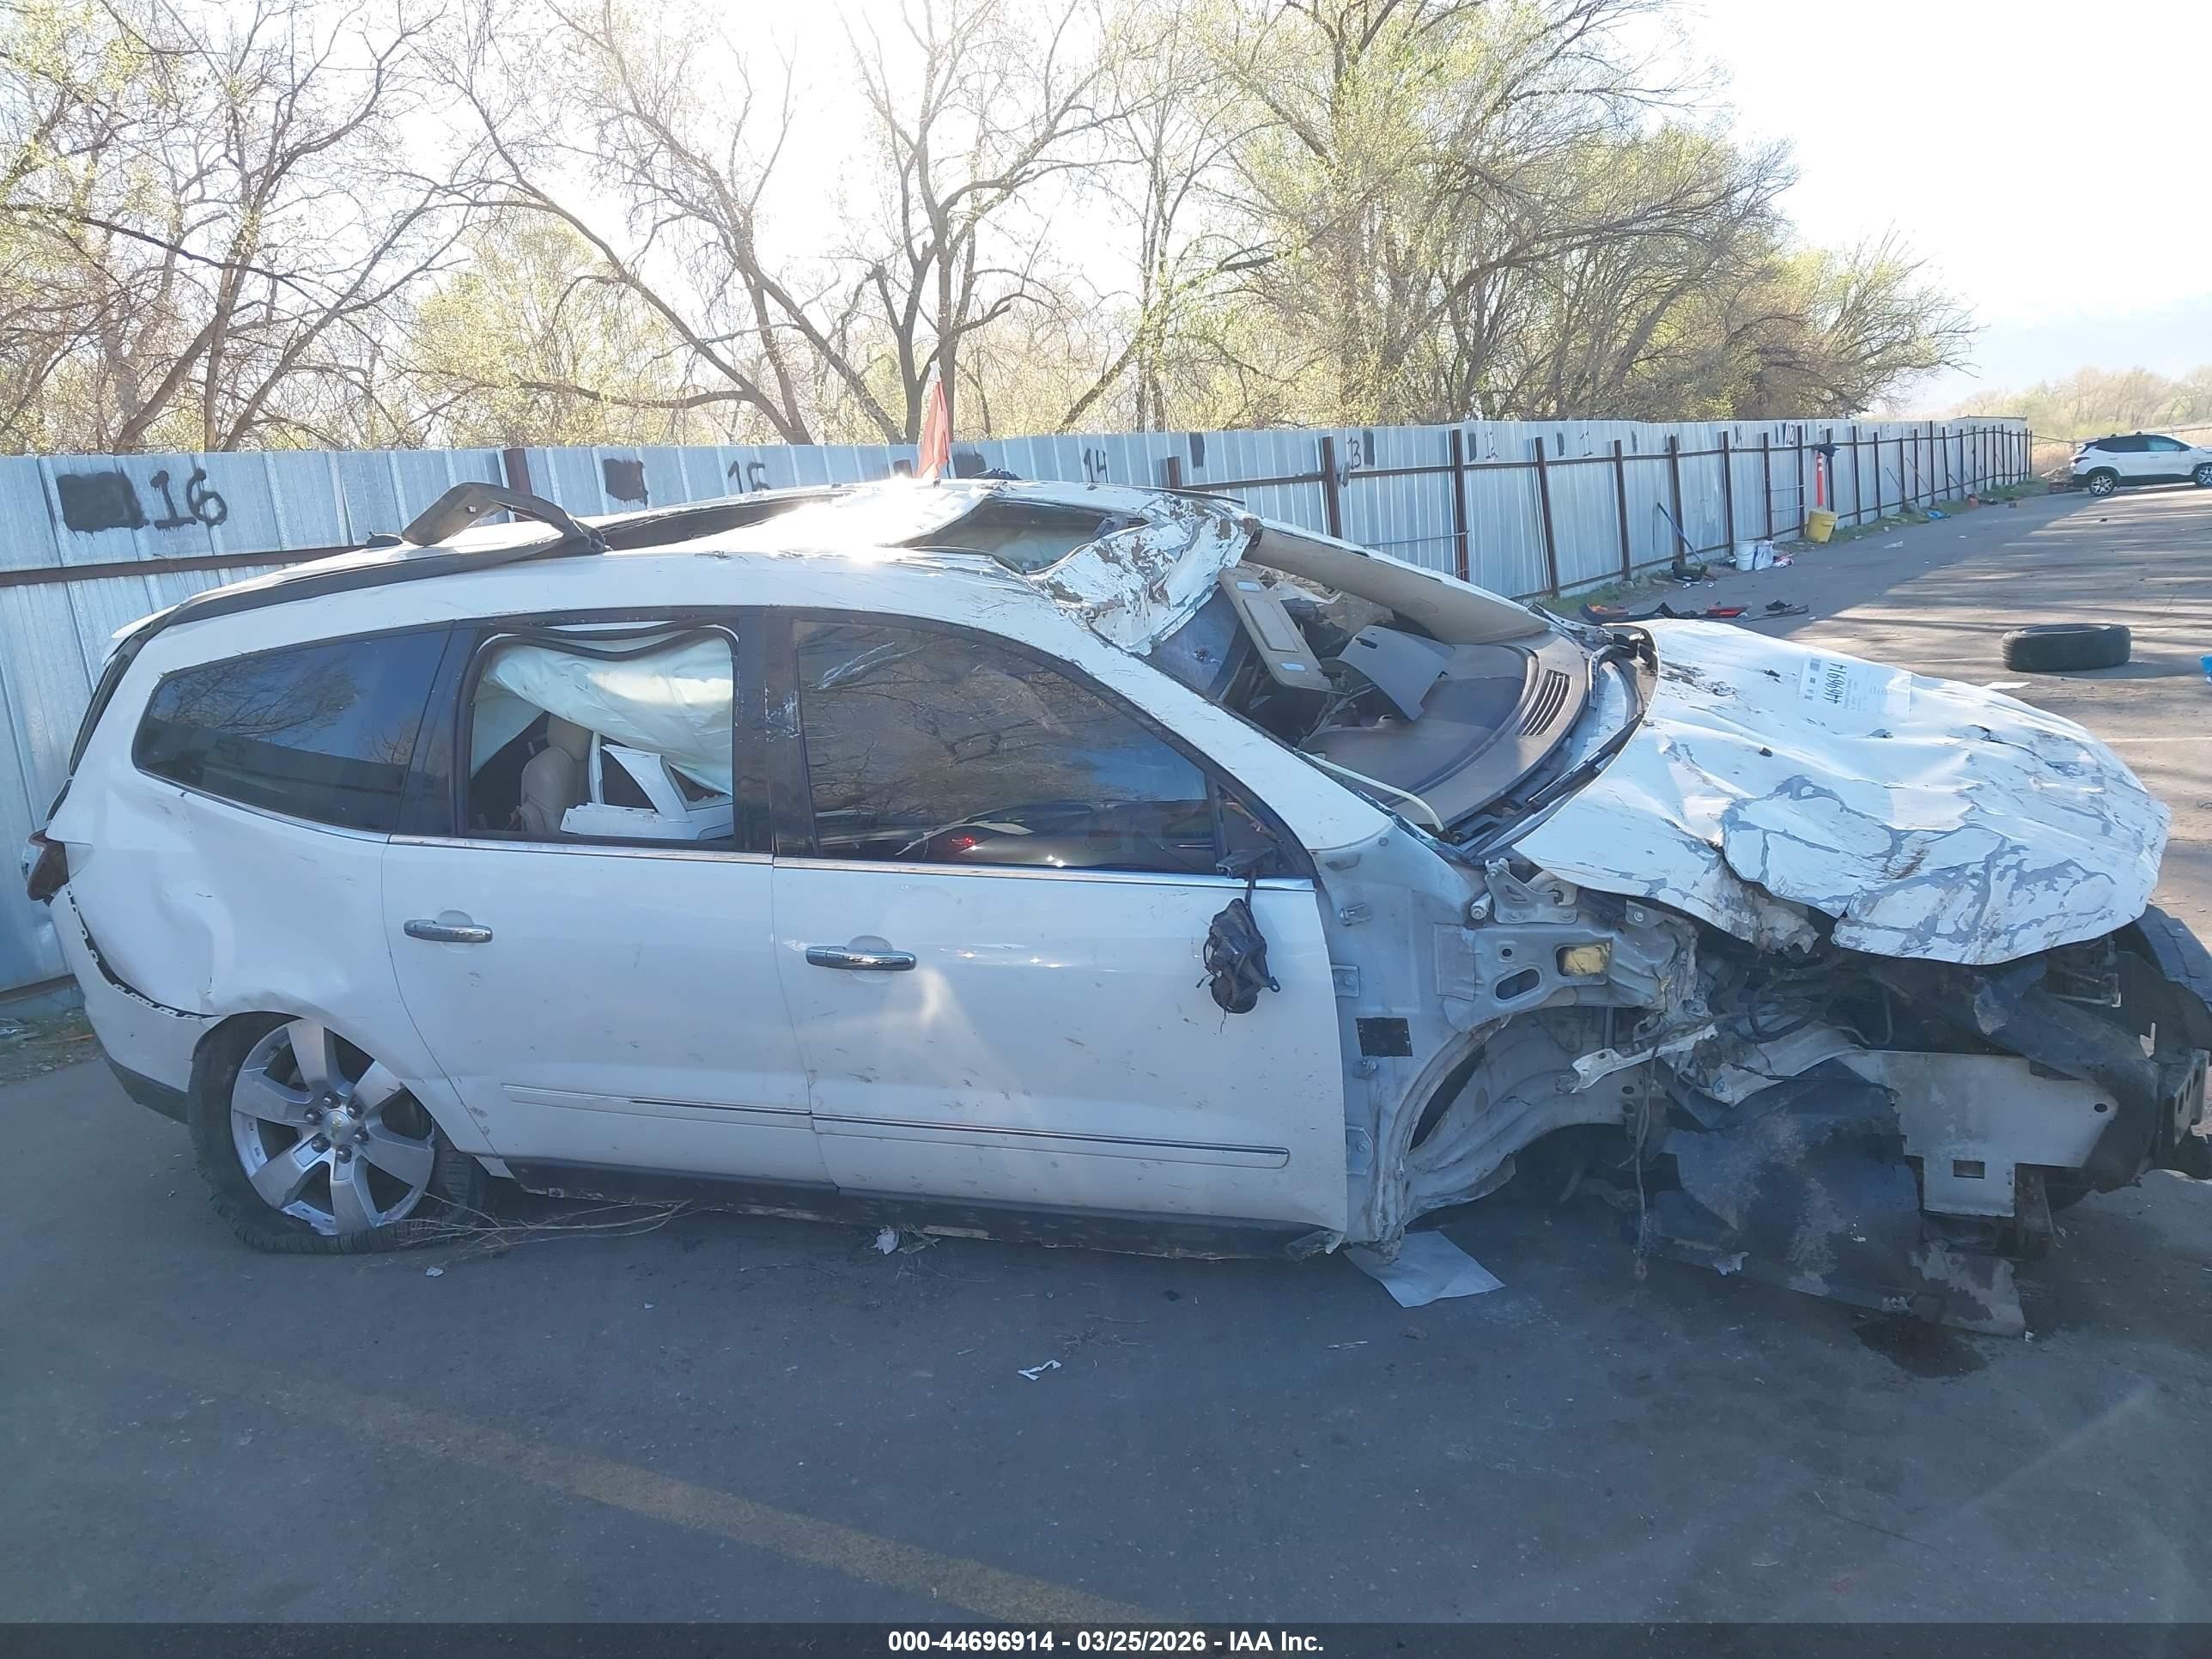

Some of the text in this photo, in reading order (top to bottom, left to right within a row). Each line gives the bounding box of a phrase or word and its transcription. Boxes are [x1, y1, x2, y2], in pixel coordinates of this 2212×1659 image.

[1083, 447, 1109, 483] 14
[1346, 437, 1362, 470] 13
[727, 460, 772, 494] 15
[149, 468, 228, 534] 16
[1821, 661, 1848, 705] 44696914
